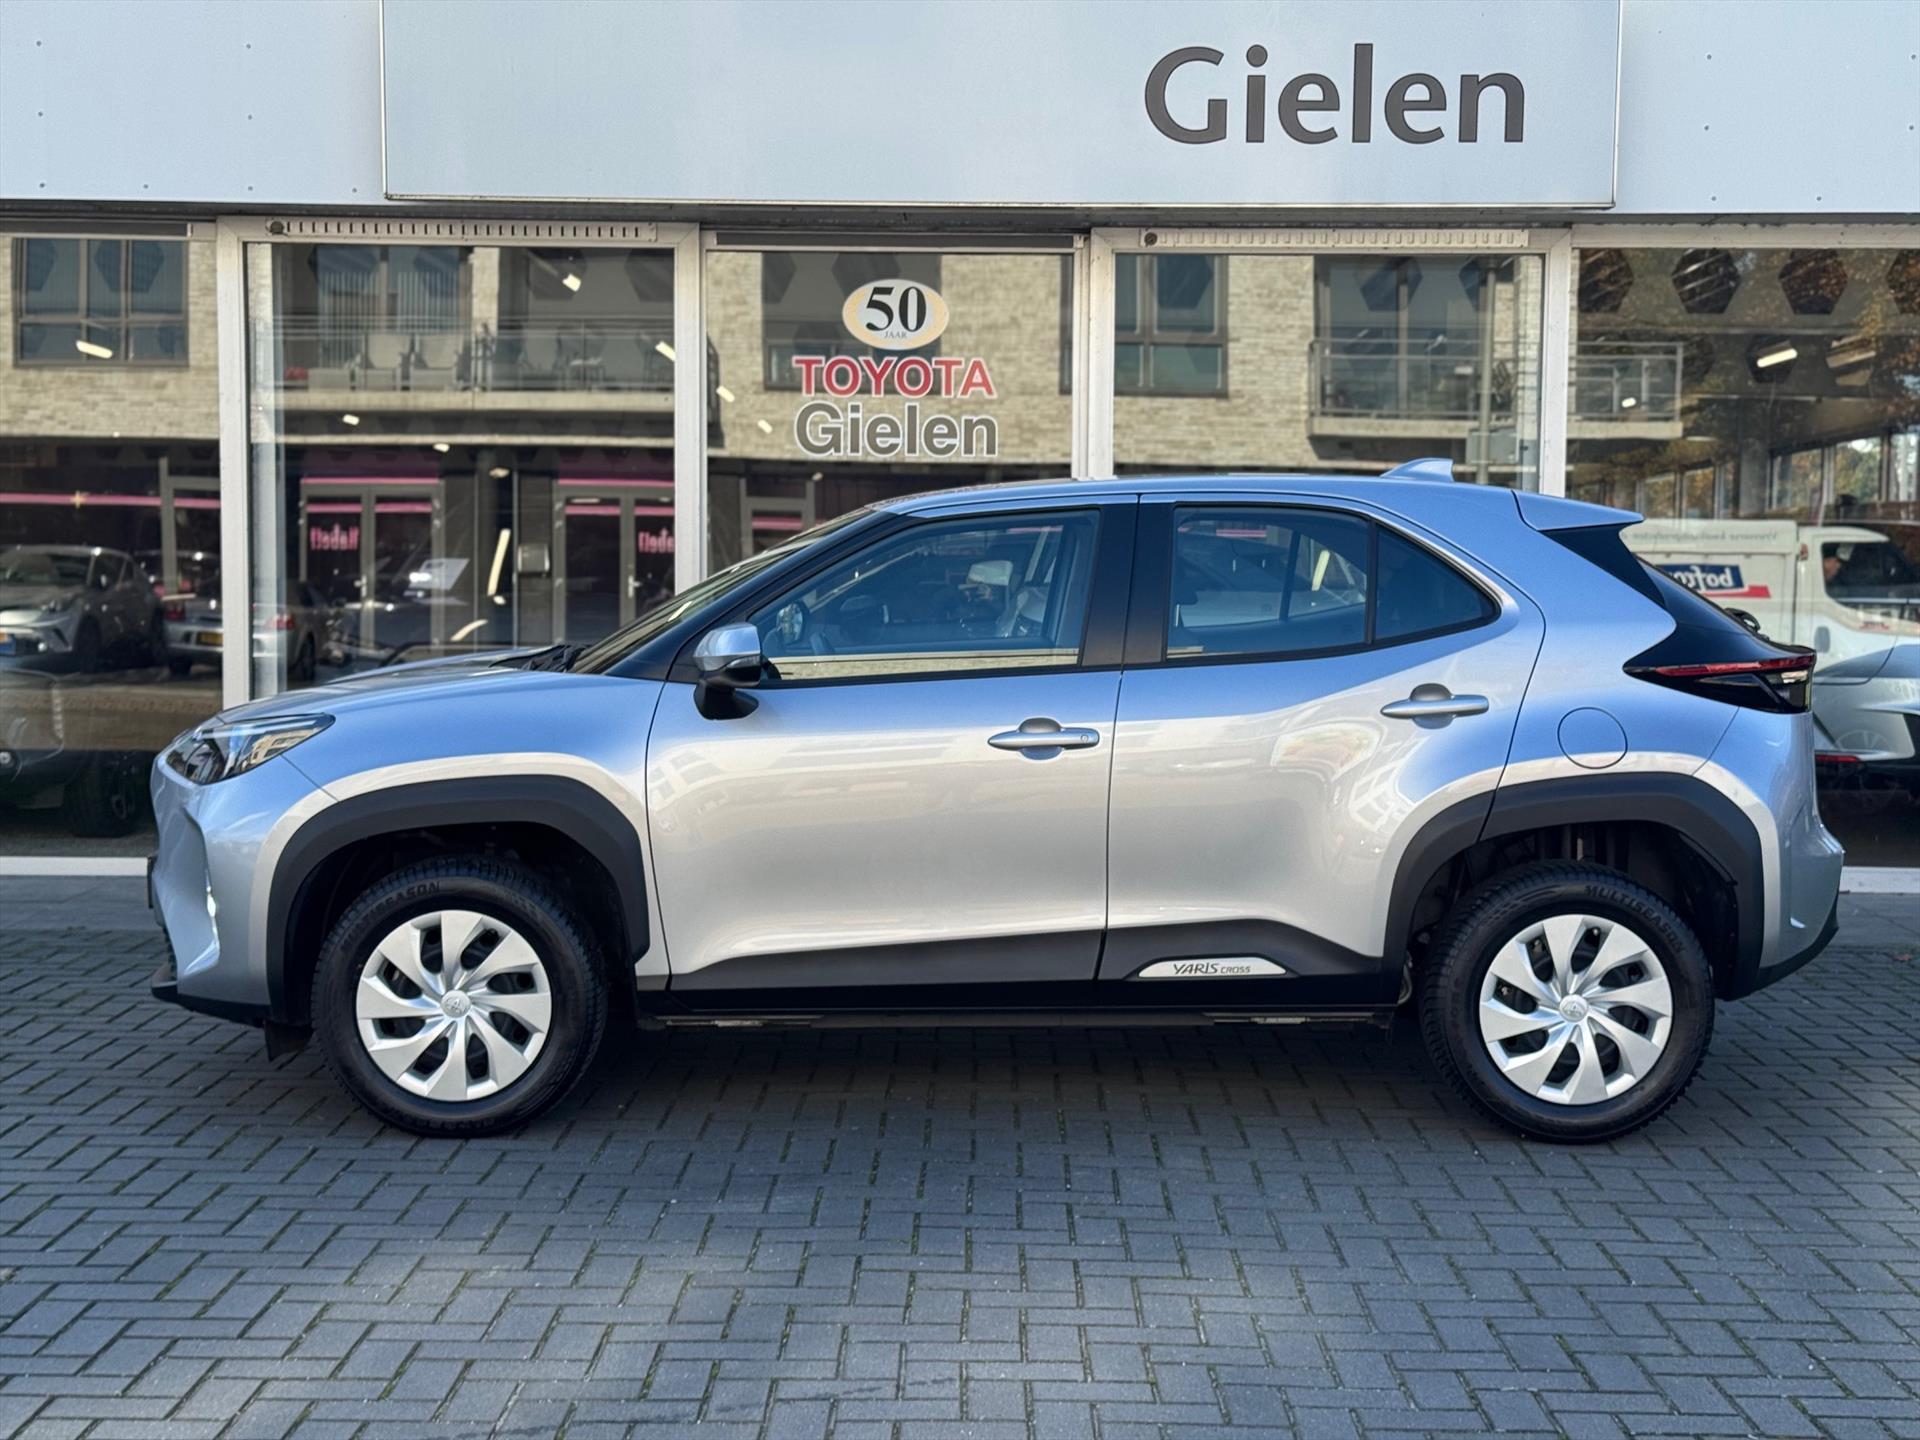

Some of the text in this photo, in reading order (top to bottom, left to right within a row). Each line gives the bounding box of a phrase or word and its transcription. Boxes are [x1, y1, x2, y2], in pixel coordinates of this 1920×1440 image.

[1144, 43, 1525, 145] Gielen
[866, 286, 927, 332] 50
[884, 330, 908, 339] JAAR
[793, 356, 996, 398] TOYOTA
[795, 401, 998, 457] Gielen
[1584, 885, 1687, 954] MULTISEASON
[1173, 962, 1251, 975] YARIS CROSS
